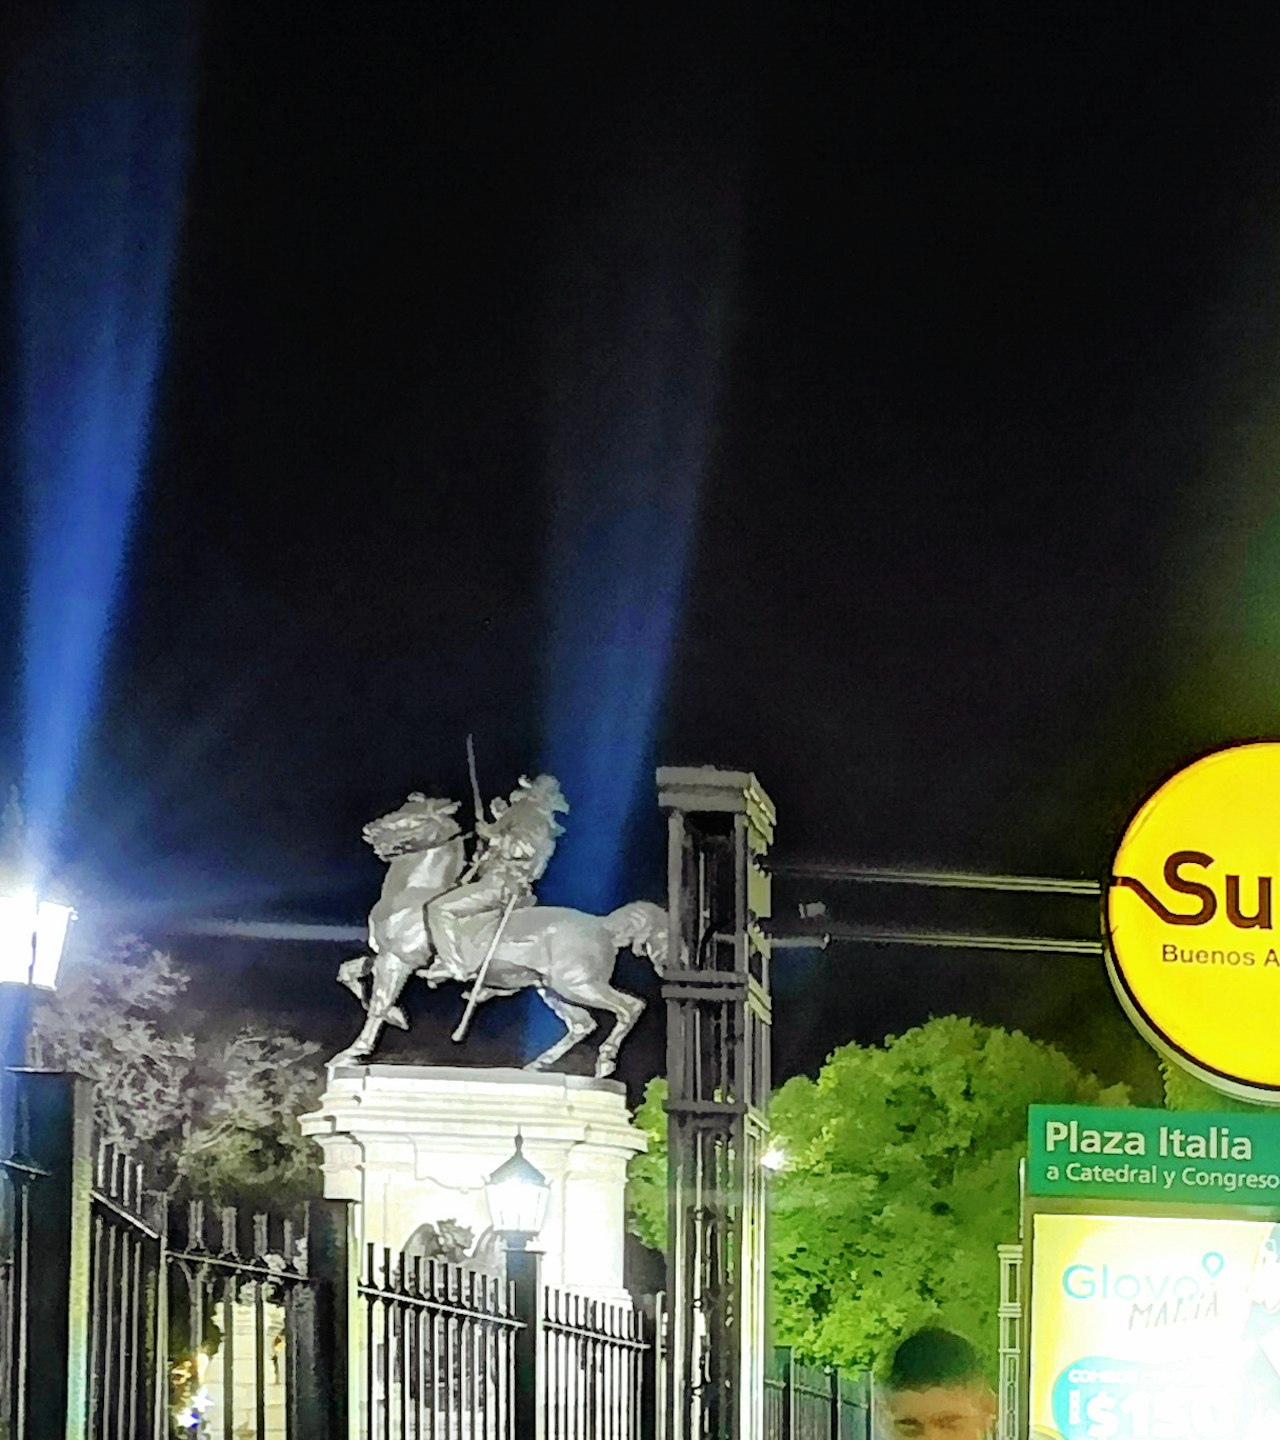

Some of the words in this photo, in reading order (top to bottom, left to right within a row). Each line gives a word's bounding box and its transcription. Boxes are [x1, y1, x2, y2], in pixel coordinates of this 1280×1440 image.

[1161, 943, 1255, 967] Buenos
[1045, 1121, 1146, 1157] Plaza
[1158, 1126, 1252, 1161] Italia
[1046, 1169, 1059, 1182] a
[1065, 1162, 1158, 1185] Catedral
[1163, 1170, 1176, 1188] y
[1181, 1168, 1280, 1192] Congreso
[1062, 1262, 1202, 1300] Glovo
